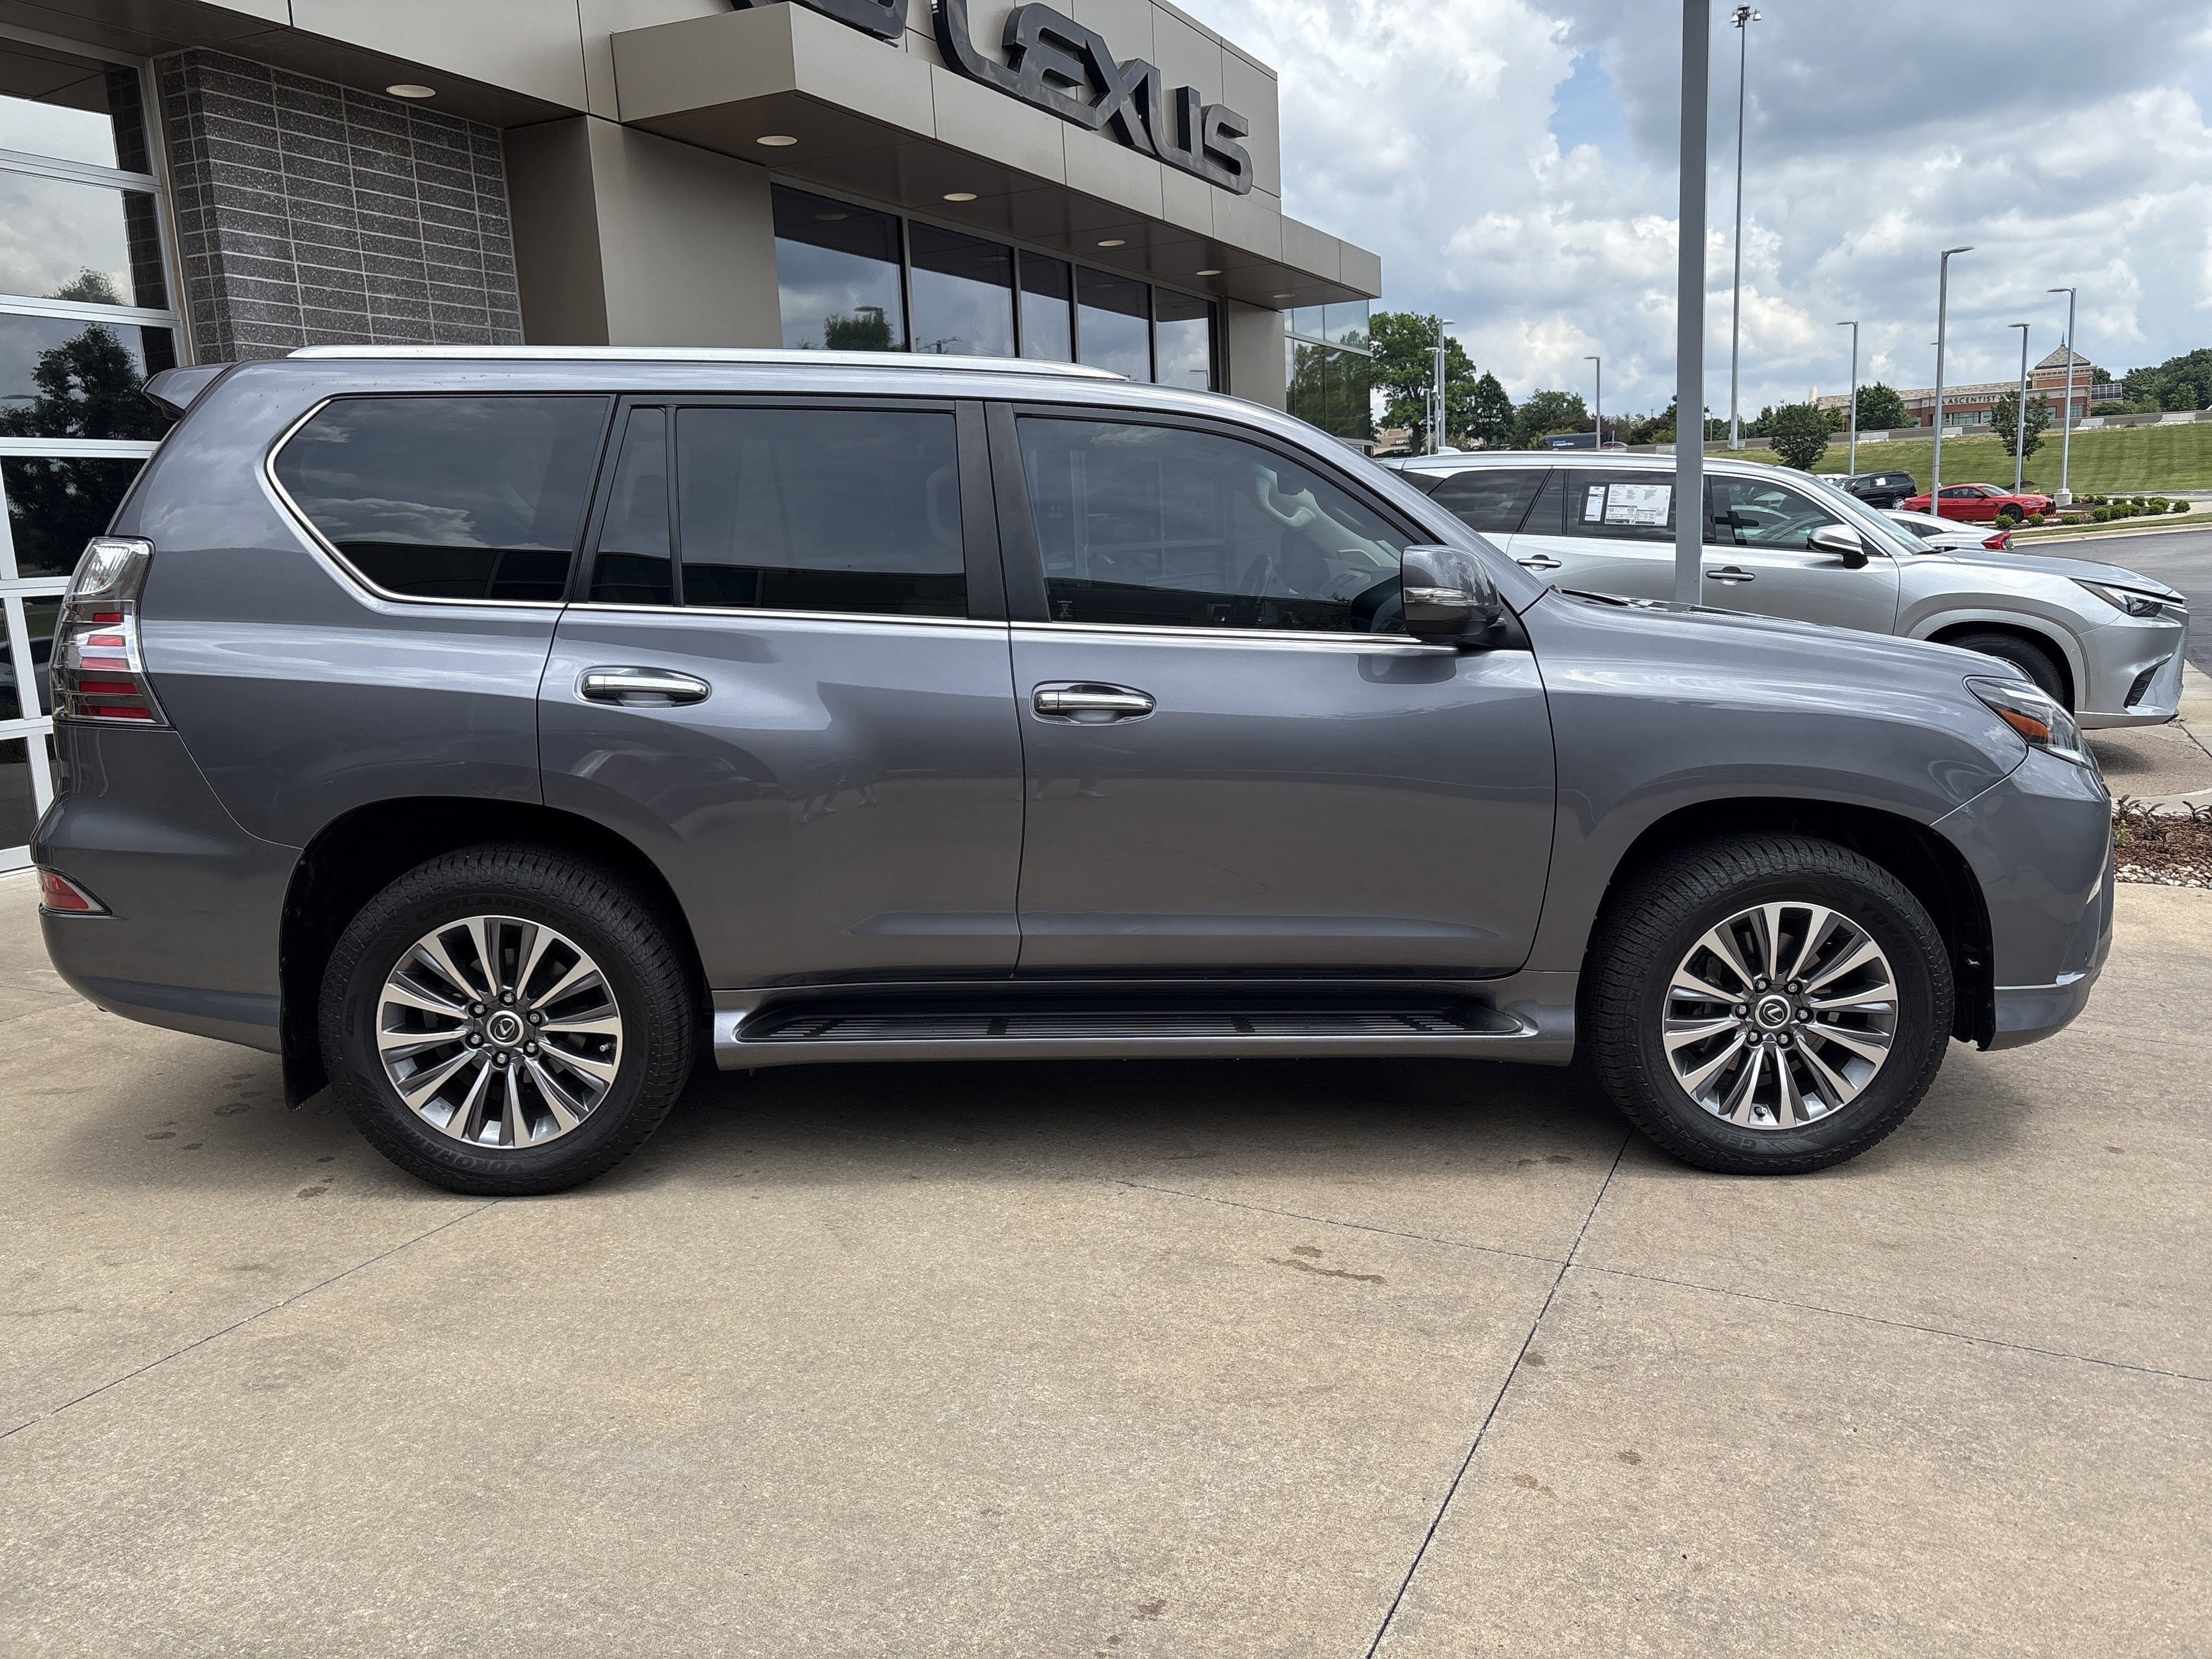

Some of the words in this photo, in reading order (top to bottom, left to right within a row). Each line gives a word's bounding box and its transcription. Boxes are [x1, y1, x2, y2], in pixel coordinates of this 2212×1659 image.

[932, 0, 1253, 196] LEXUS
[1948, 395, 1996, 404] ASCENTIST
[416, 896, 565, 922] GEOLANDAR
[390, 1119, 529, 1174] YOKOHAMA
